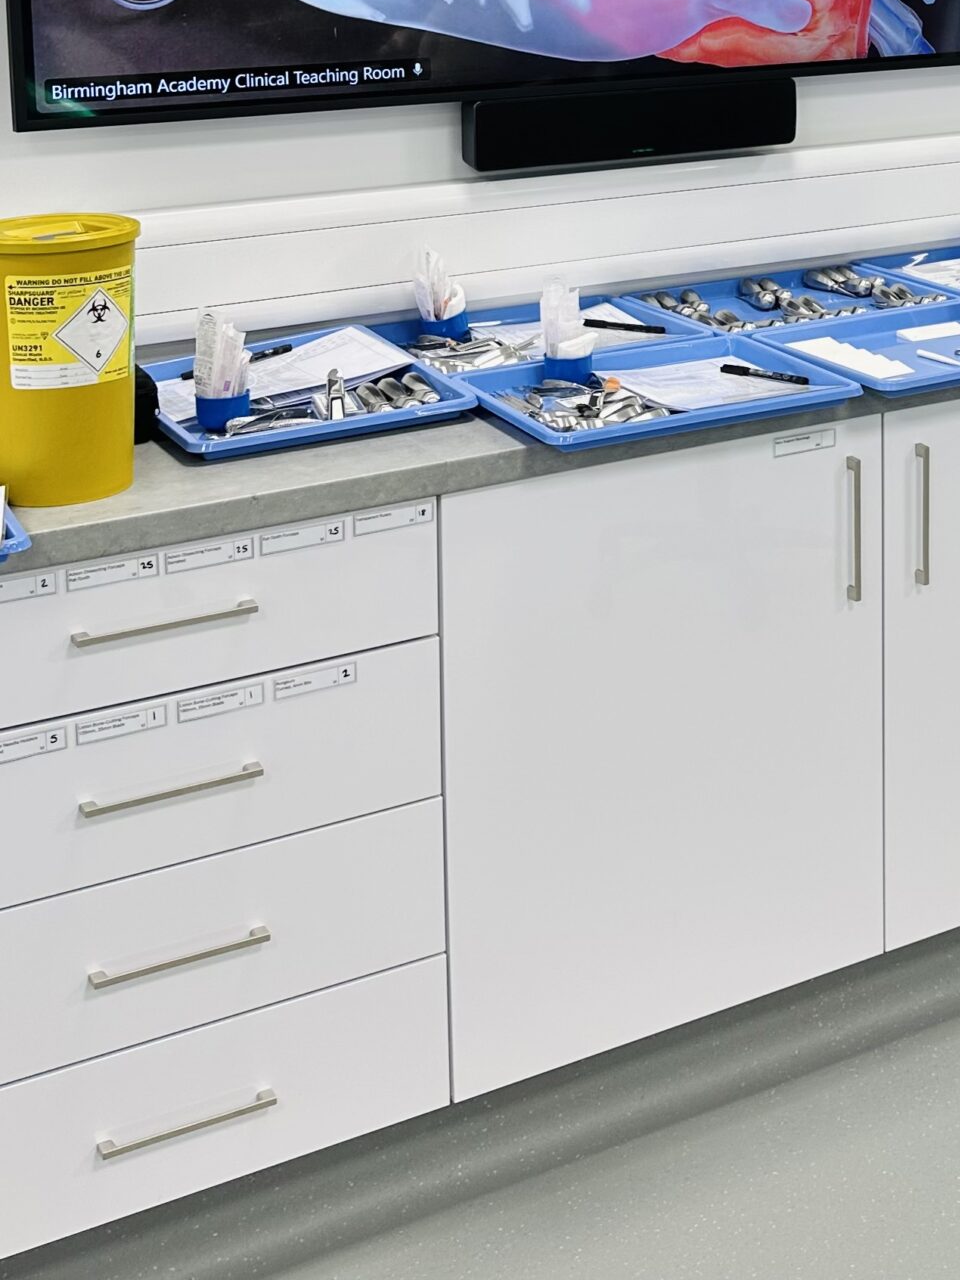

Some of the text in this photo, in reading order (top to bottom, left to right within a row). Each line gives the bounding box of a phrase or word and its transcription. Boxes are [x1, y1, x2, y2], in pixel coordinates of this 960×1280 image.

[51, 66, 405, 101] Birmingham Academy Clinical Teaching Room
[94, 272, 113, 281] ABOVE
[9, 297, 54, 306] DANGER
[12, 344, 43, 352] UN3291
[95, 349, 102, 359] 6
[328, 526, 340, 535] 25
[236, 544, 249, 554] 25
[140, 560, 154, 570] 25
[40, 578, 48, 588] 2
[341, 668, 351, 678] 2
[50, 734, 58, 744] 5
